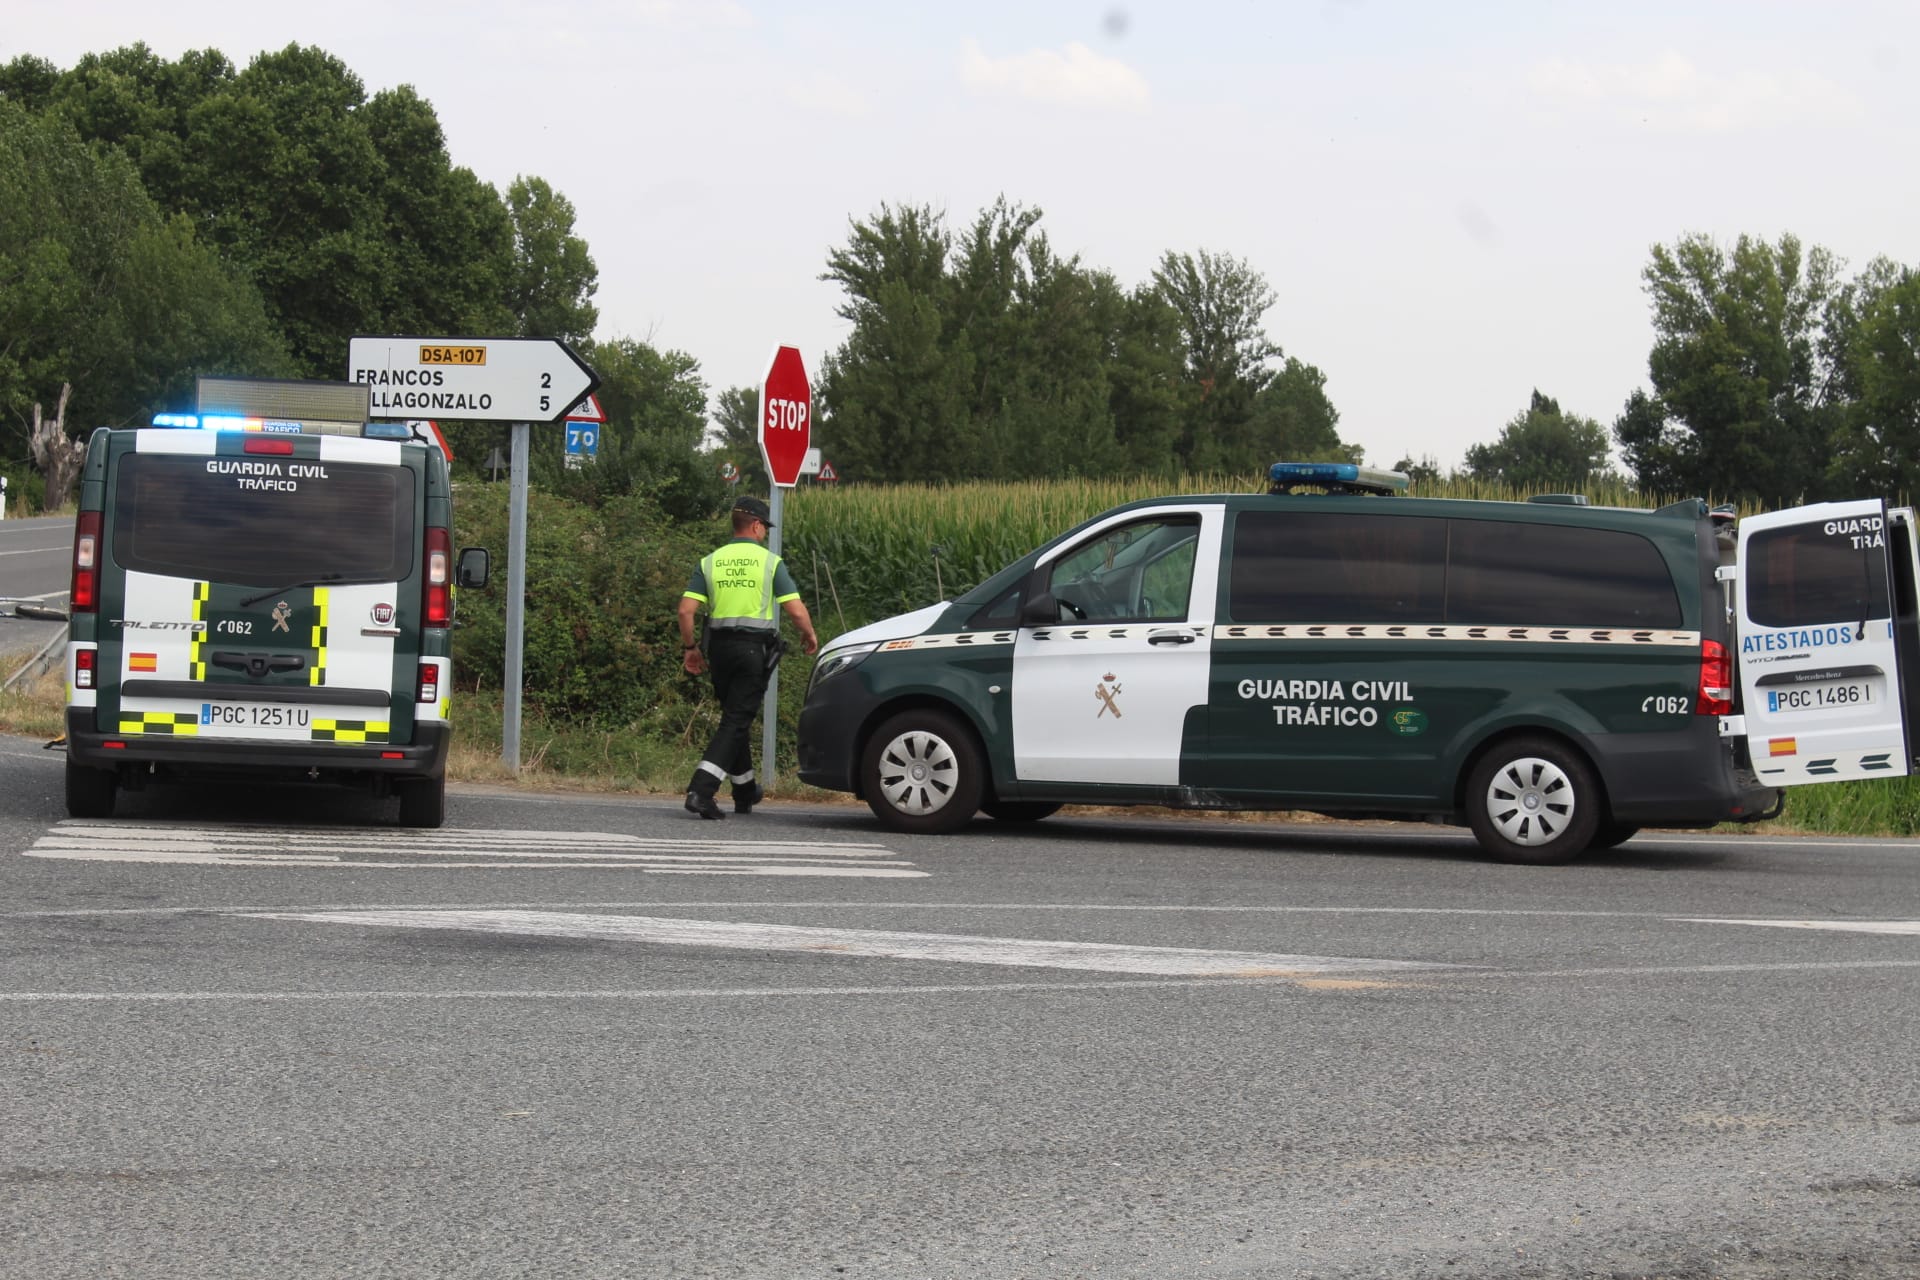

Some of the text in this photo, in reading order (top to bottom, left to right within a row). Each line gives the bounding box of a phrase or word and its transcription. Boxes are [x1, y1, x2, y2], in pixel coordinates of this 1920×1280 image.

[421, 348, 485, 363] DSA-107
[356, 369, 552, 389] FRANCOS 2
[371, 391, 551, 412] LLAGONZALO 5
[767, 397, 807, 432] STOP
[569, 430, 595, 447] 70
[206, 460, 329, 479] GUARDIA CIVIL
[237, 476, 297, 492] TRÁFICO
[715, 558, 760, 568] GUARDIA
[726, 567, 748, 577] CIVIL
[376, 607, 391, 620] FIAT
[109, 618, 206, 631] TALENTO
[227, 619, 253, 635] 062
[1742, 625, 1852, 654] ATESTADOS
[1795, 671, 1842, 681] Mercedes-Benz
[1237, 678, 1414, 702] GUARDIA CIVIL
[1777, 690, 1811, 710] PGC
[1816, 685, 1860, 705] 1486
[1655, 695, 1689, 714] 062
[211, 705, 246, 724] PGC
[251, 707, 292, 726] 1251
[297, 709, 309, 727] U
[1272, 702, 1379, 727] TRÁFICO
